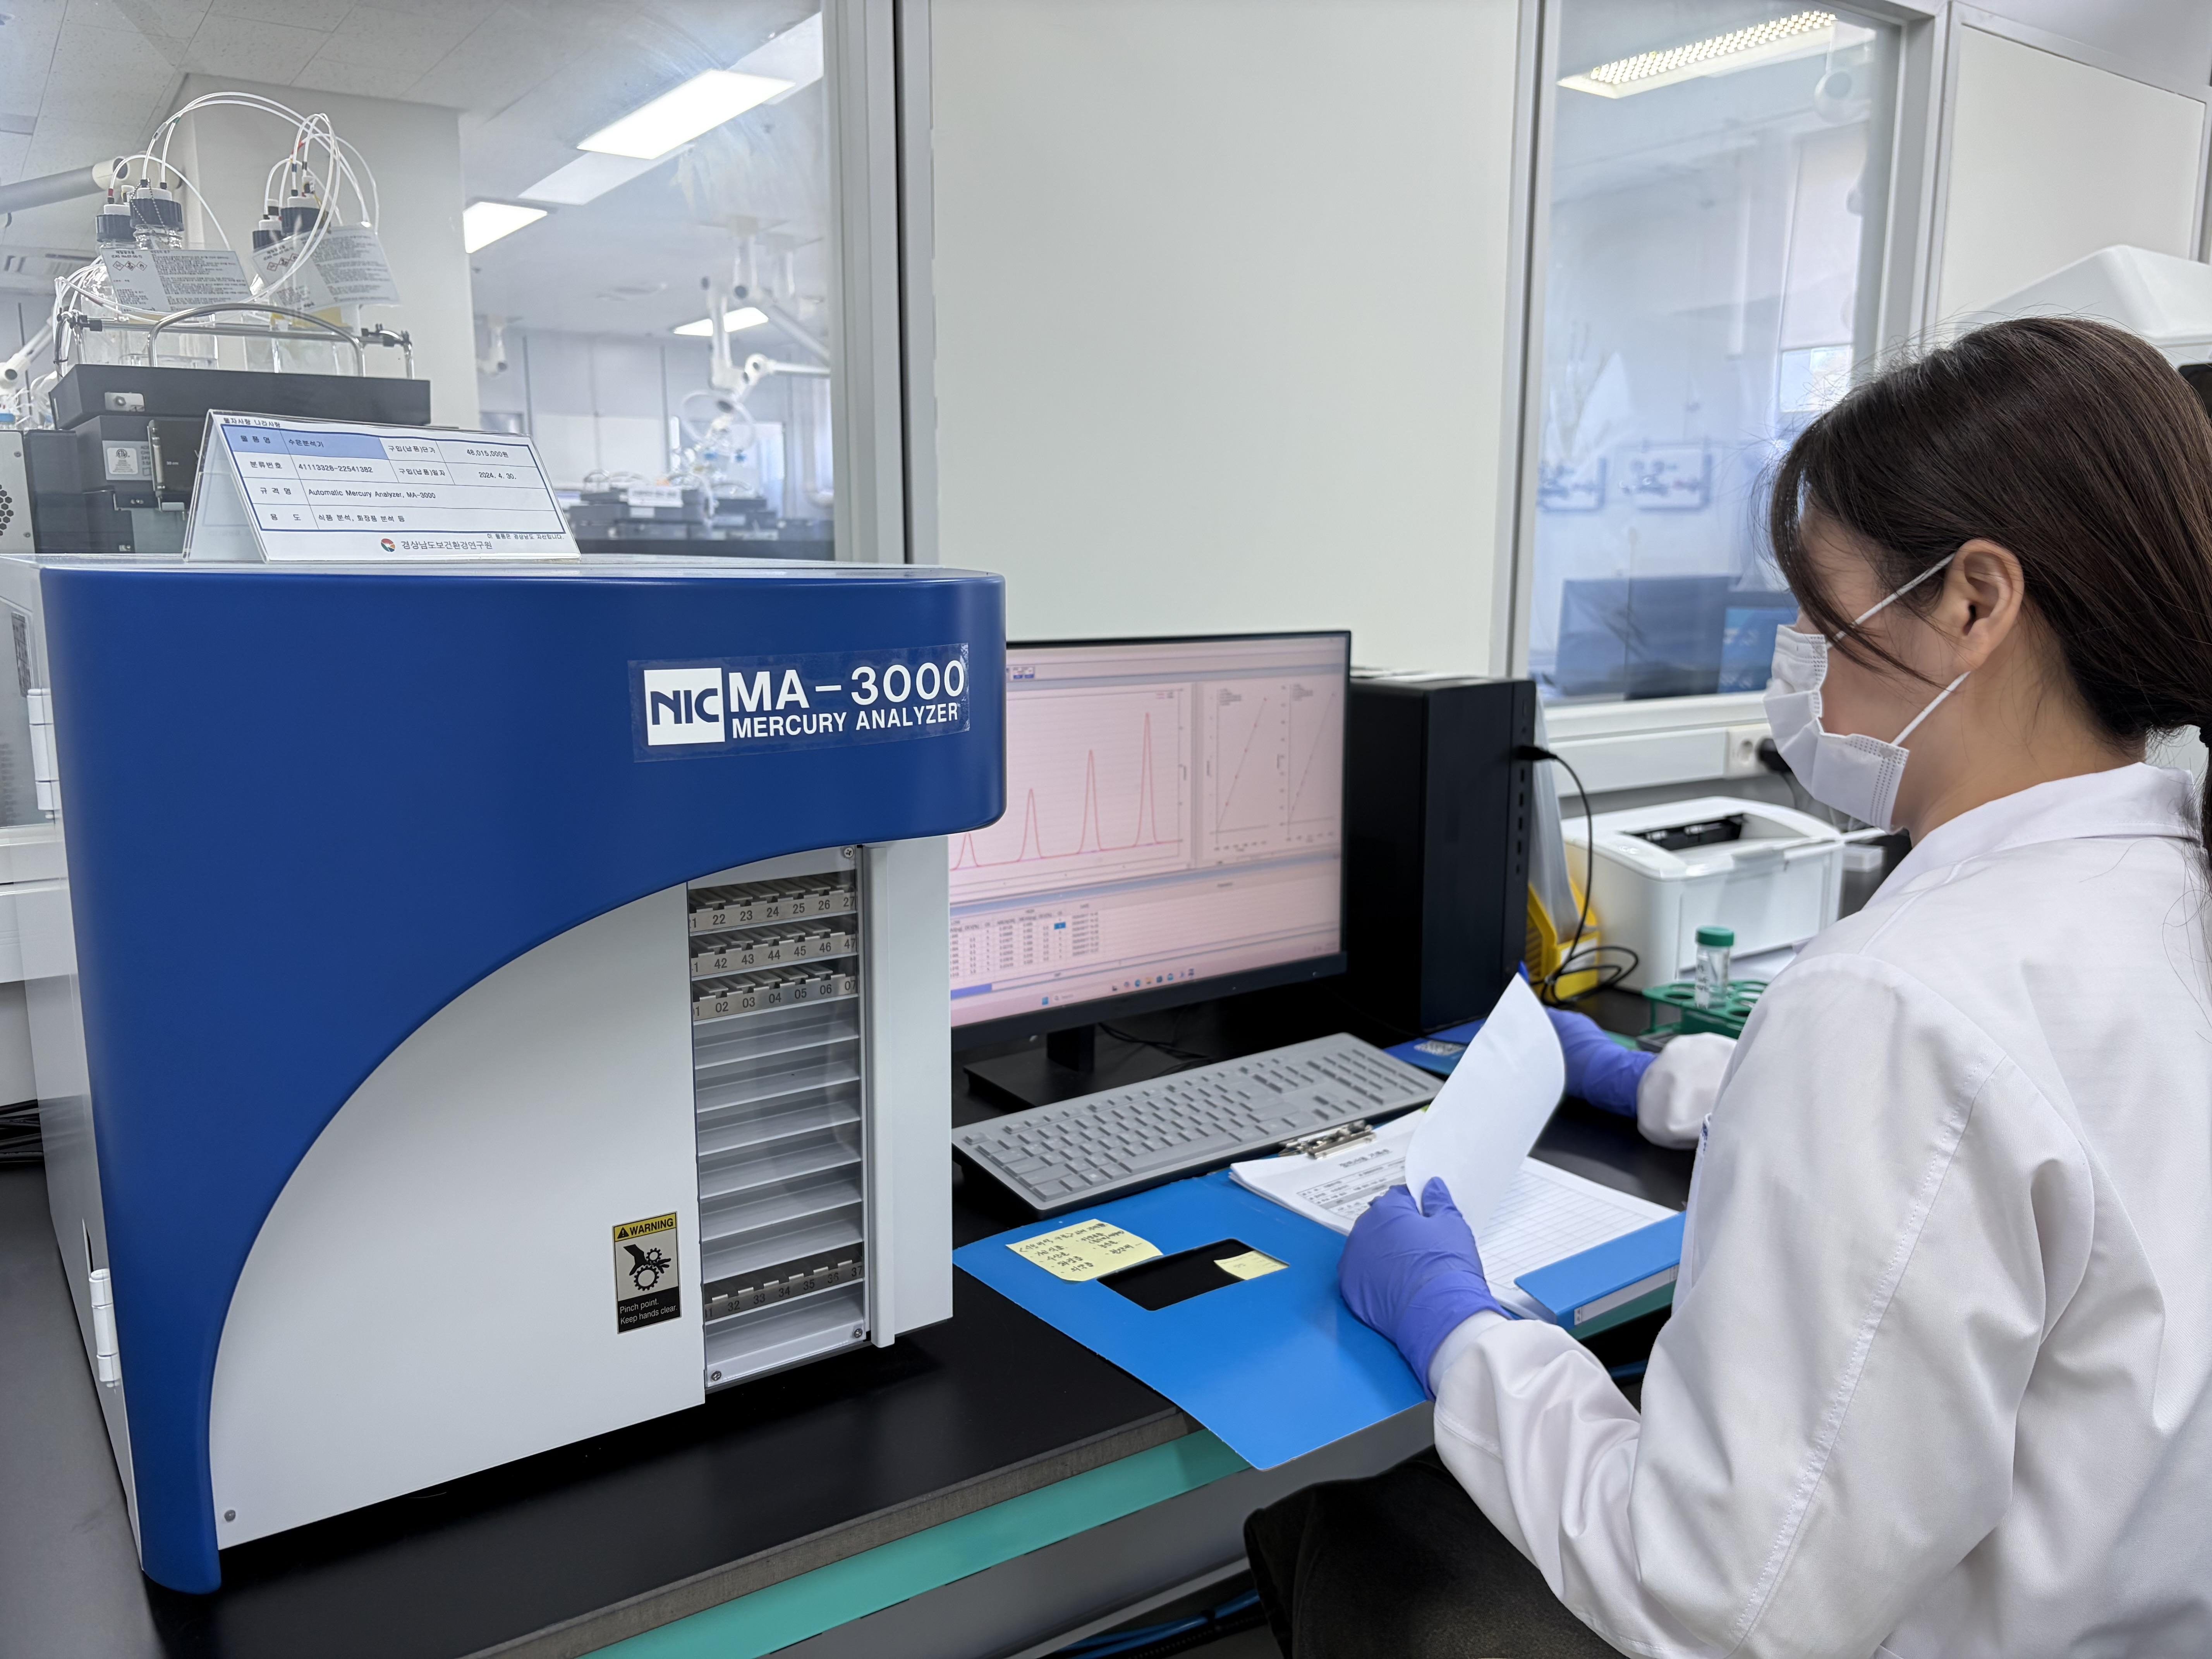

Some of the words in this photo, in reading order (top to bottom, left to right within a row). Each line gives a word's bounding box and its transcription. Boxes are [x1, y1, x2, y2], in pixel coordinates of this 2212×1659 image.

[254, 420, 281, 428] 나라사랑
[289, 439, 324, 448] 수은분석기
[388, 445, 436, 453] 구입(납품)단가
[467, 449, 509, 458] 48,015,000원
[299, 464, 374, 473] 41113328-22541382
[398, 468, 446, 476] 구입(납품)일자
[345, 490, 372, 498] Mercury
[401, 541, 493, 550] 경상남도보건환경연구원
[651, 688, 719, 725] NIC
[732, 712, 847, 738] MERCURY
[855, 702, 958, 730] ANALYZER
[713, 914, 726, 925] 22
[740, 910, 753, 921] 23
[767, 907, 779, 918] 24
[793, 903, 805, 914] 25
[818, 900, 830, 910] 26
[843, 896, 855, 907] 27
[714, 958, 727, 969] 42
[742, 954, 754, 965] 43
[768, 950, 781, 961] 44
[794, 946, 806, 957] 45
[819, 942, 831, 953] 46
[844, 938, 855, 949] 47
[715, 1002, 728, 1013] 02
[742, 997, 755, 1008] 03
[769, 993, 781, 1003] 04
[795, 988, 807, 999] 05
[820, 984, 832, 995] 06
[845, 980, 856, 991] 07
[630, 1218, 673, 1235] WARNING
[728, 1300, 740, 1311] 32
[753, 1294, 766, 1304] 33
[778, 1286, 790, 1297] 34
[804, 1279, 815, 1290] 35
[828, 1273, 839, 1283] 36
[852, 1266, 862, 1276] 37
[620, 1303, 639, 1314] Pinch
[641, 1298, 659, 1310] point.
[621, 1313, 637, 1324] Keep
[639, 1309, 659, 1320] hands
[660, 1305, 678, 1314] clear.
